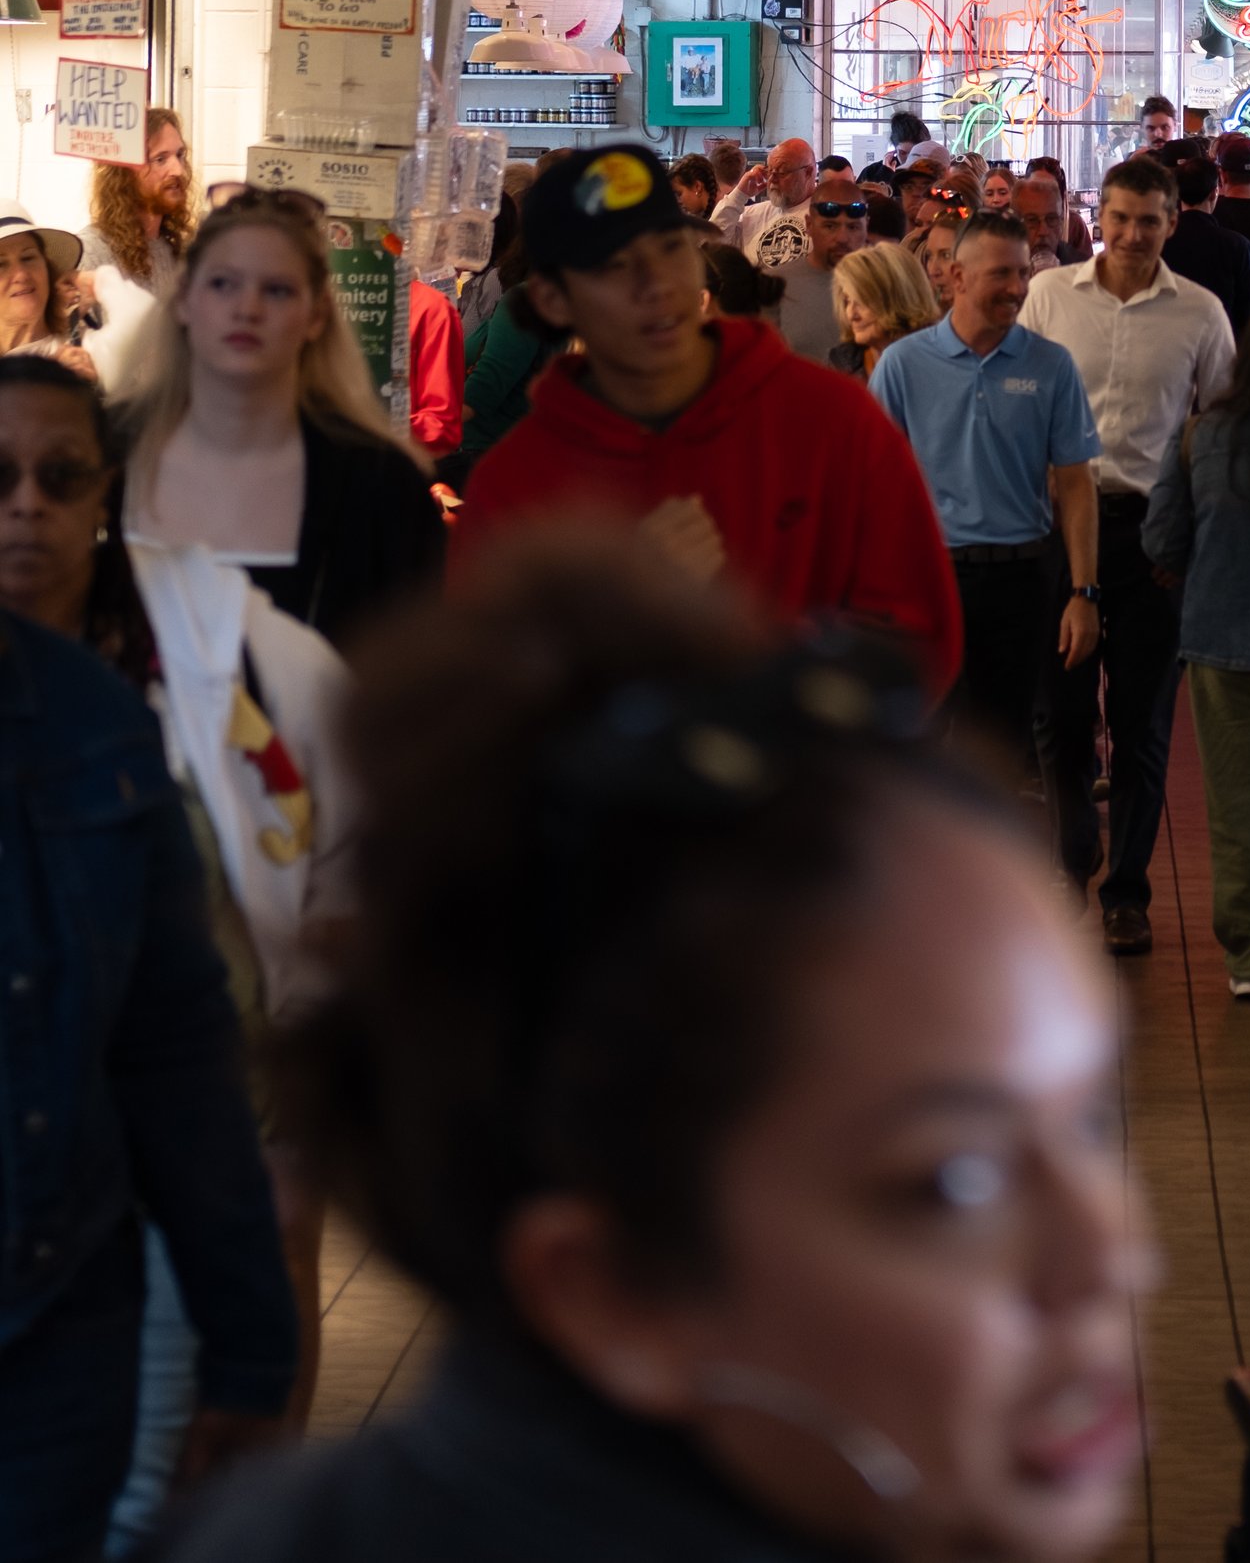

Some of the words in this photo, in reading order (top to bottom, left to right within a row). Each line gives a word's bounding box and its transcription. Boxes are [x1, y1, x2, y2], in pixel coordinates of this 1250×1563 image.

[317, 3, 335, 12] TO
[338, 4, 360, 13] GO
[296, 41, 310, 75] CARE
[69, 64, 128, 100] HELP
[57, 99, 139, 130] WANTED
[348, 274, 388, 284] OFFER
